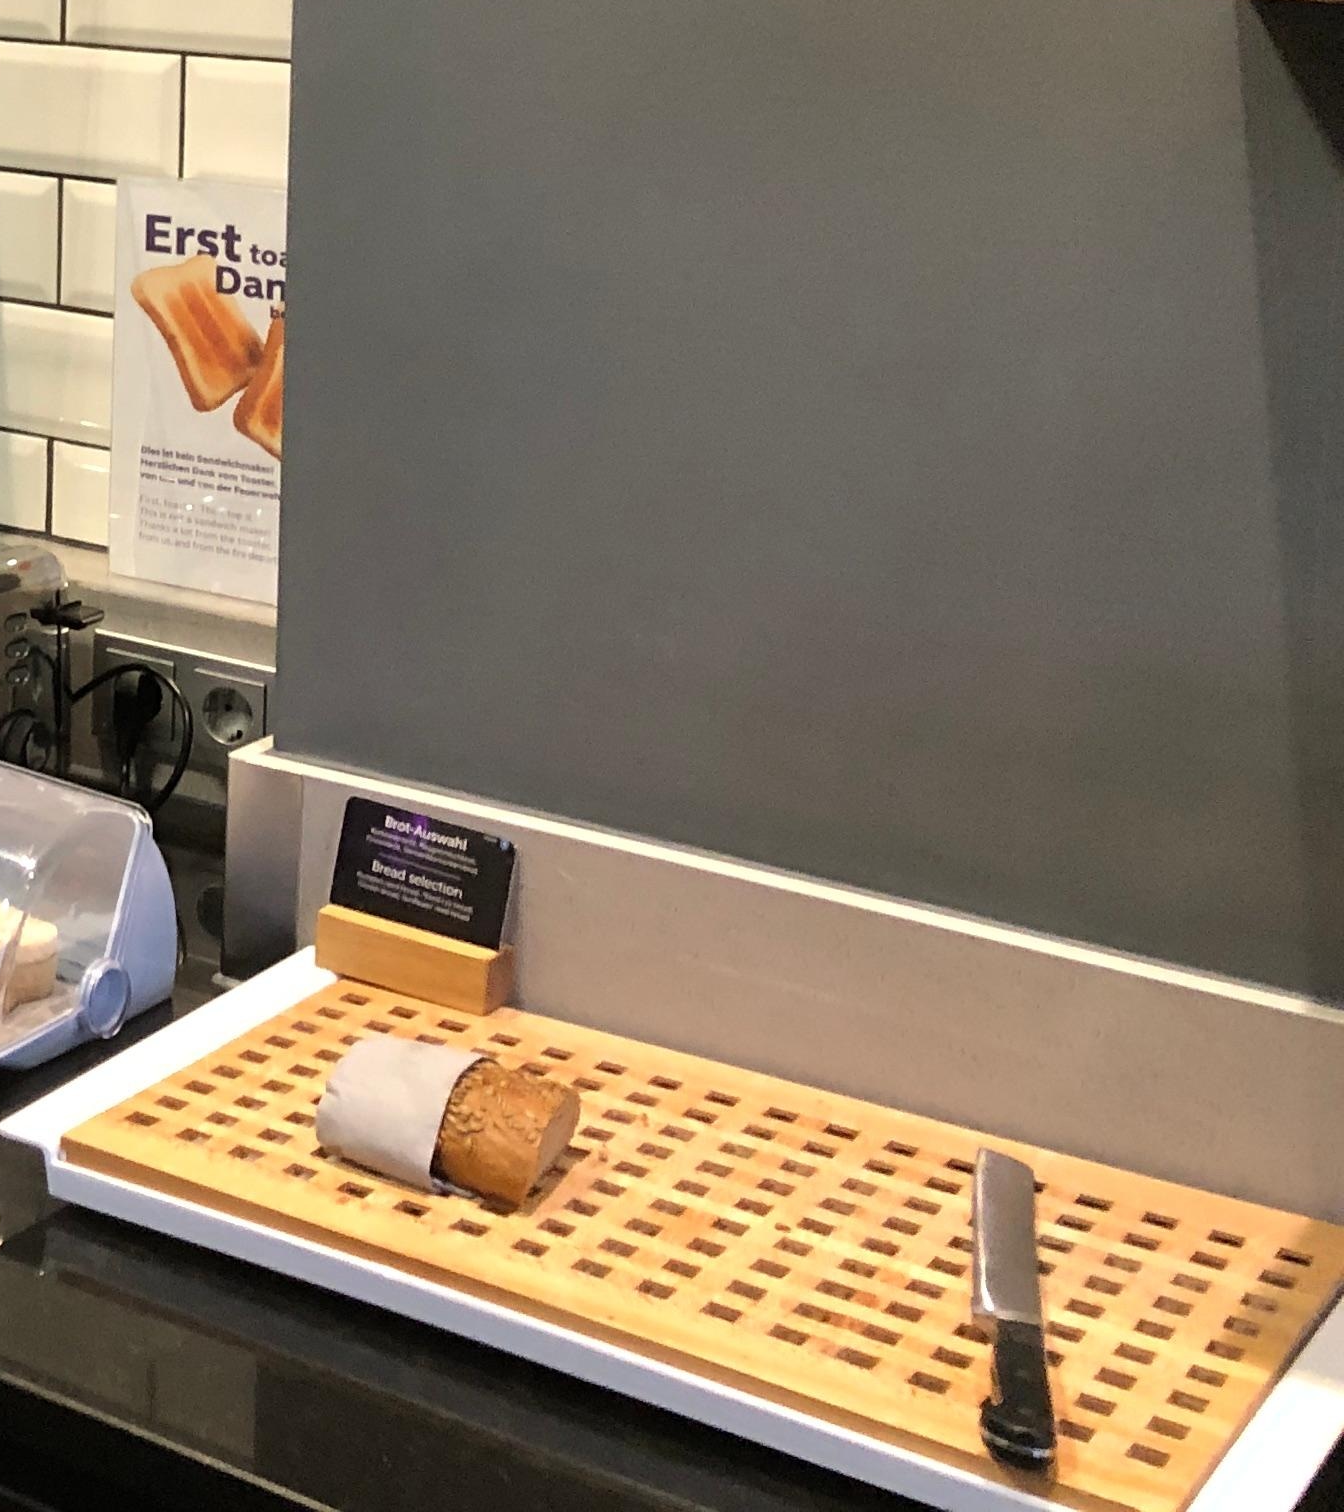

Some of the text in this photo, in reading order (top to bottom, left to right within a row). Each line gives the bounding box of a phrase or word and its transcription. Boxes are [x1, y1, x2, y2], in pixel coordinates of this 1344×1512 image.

[145, 213, 242, 262] Erst
[216, 265, 286, 302] Dan
[384, 815, 468, 852] Brot-Auswahl
[371, 859, 407, 881] Bread
[408, 872, 464, 900] selection
